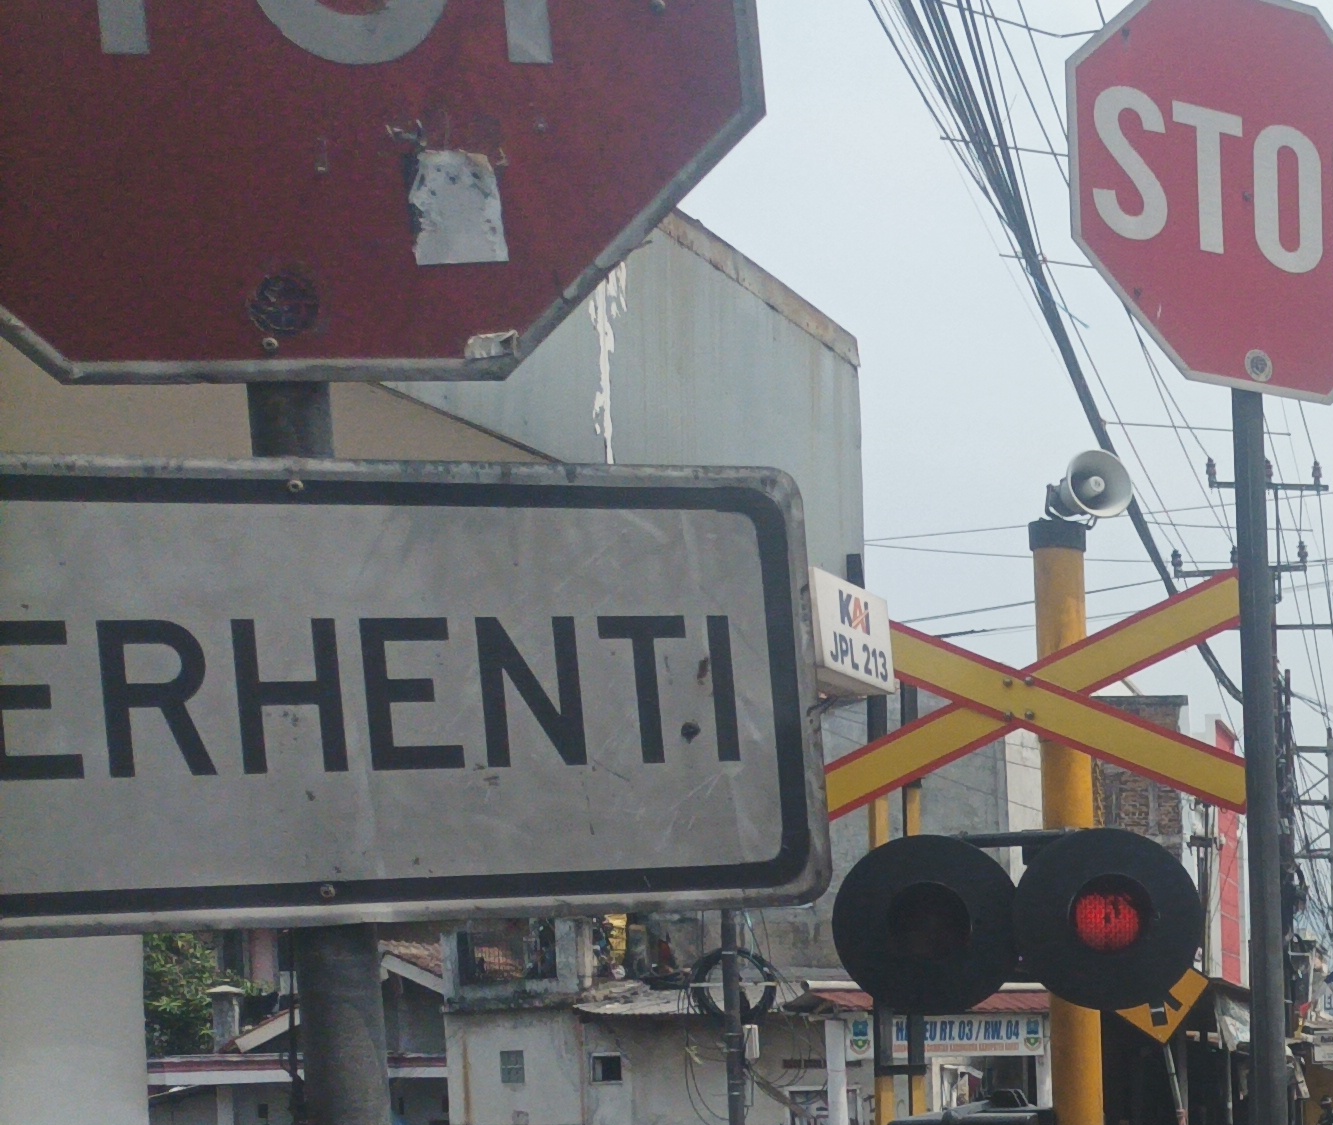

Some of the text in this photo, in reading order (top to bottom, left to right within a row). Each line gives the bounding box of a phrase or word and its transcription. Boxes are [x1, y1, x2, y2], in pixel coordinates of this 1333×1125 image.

[830, 630, 889, 683] JPL 213
[957, 1020, 973, 1041] 03
[975, 1020, 982, 1041] /
[983, 1020, 1003, 1041] RW.
[1005, 1020, 1020, 1040] 04
